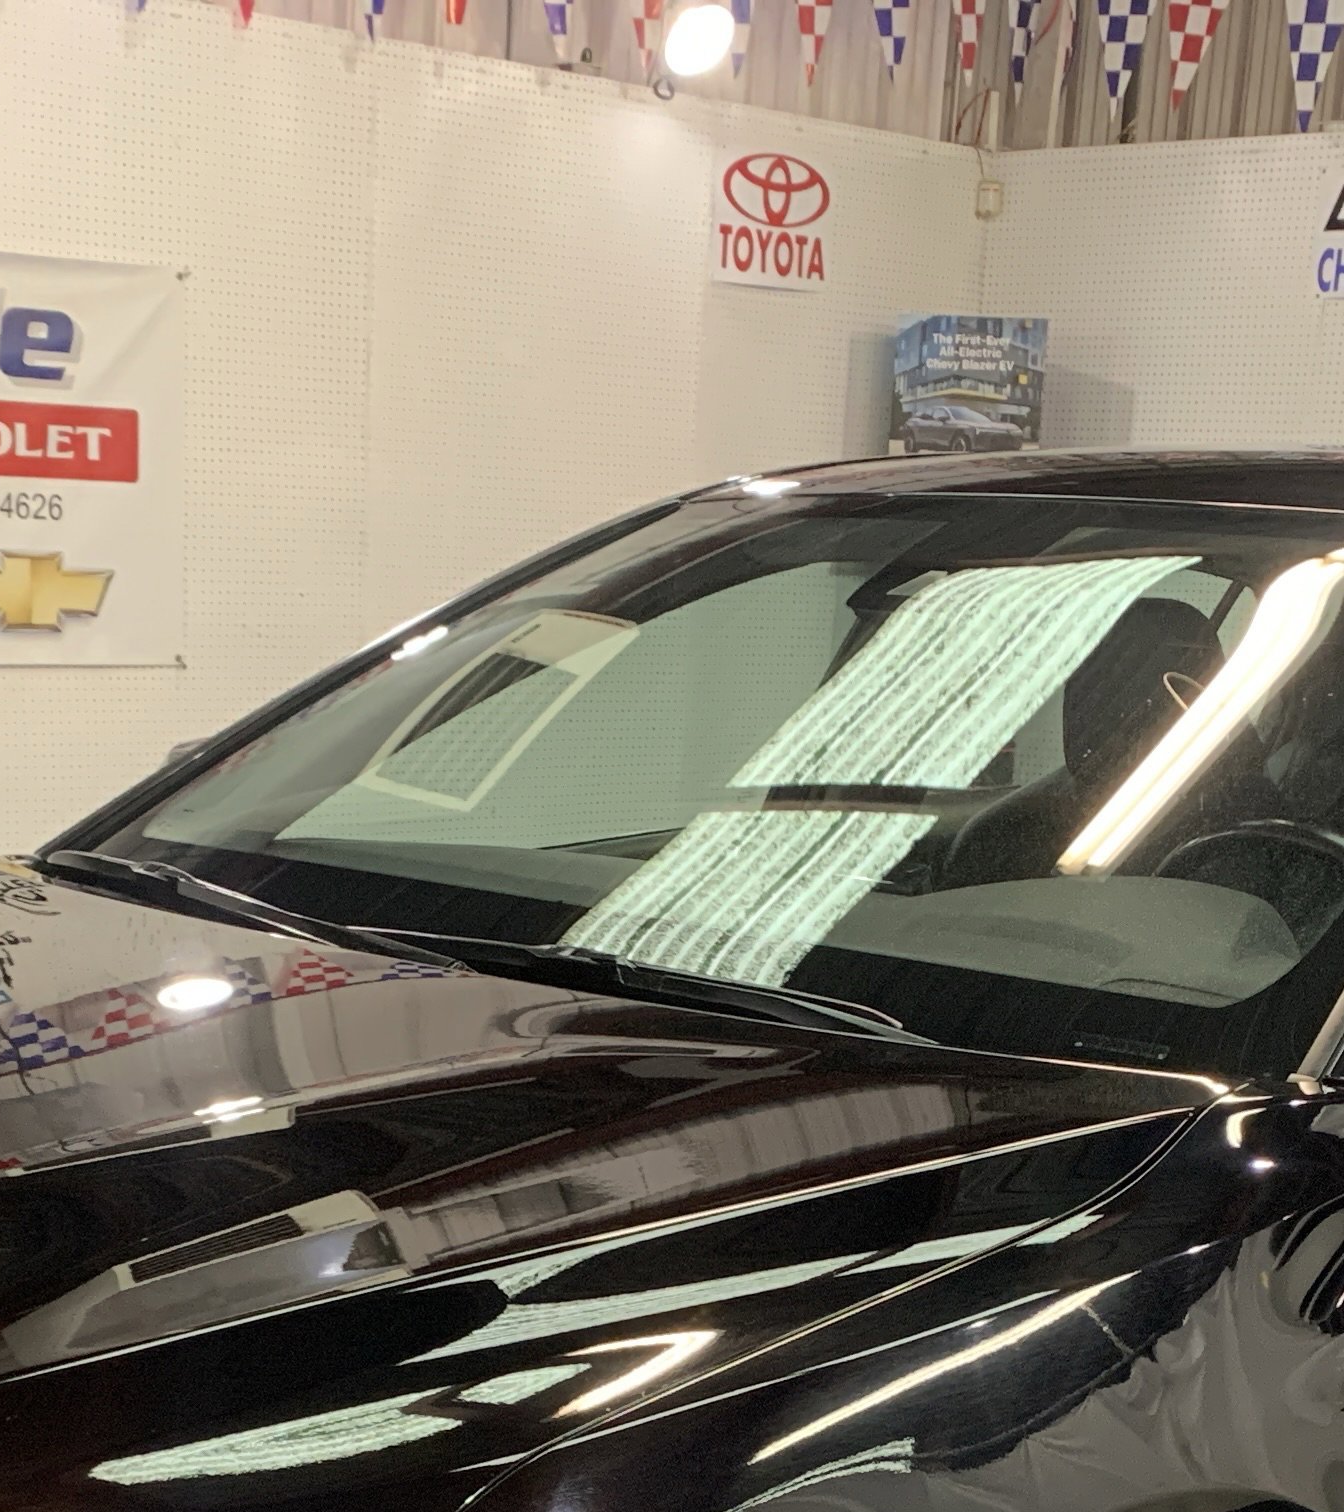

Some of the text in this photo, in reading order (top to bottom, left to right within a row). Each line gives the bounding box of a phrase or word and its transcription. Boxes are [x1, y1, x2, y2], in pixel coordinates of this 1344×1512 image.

[719, 223, 825, 281] TOYOTA
[933, 332, 953, 345] The
[999, 360, 1015, 372] EV
